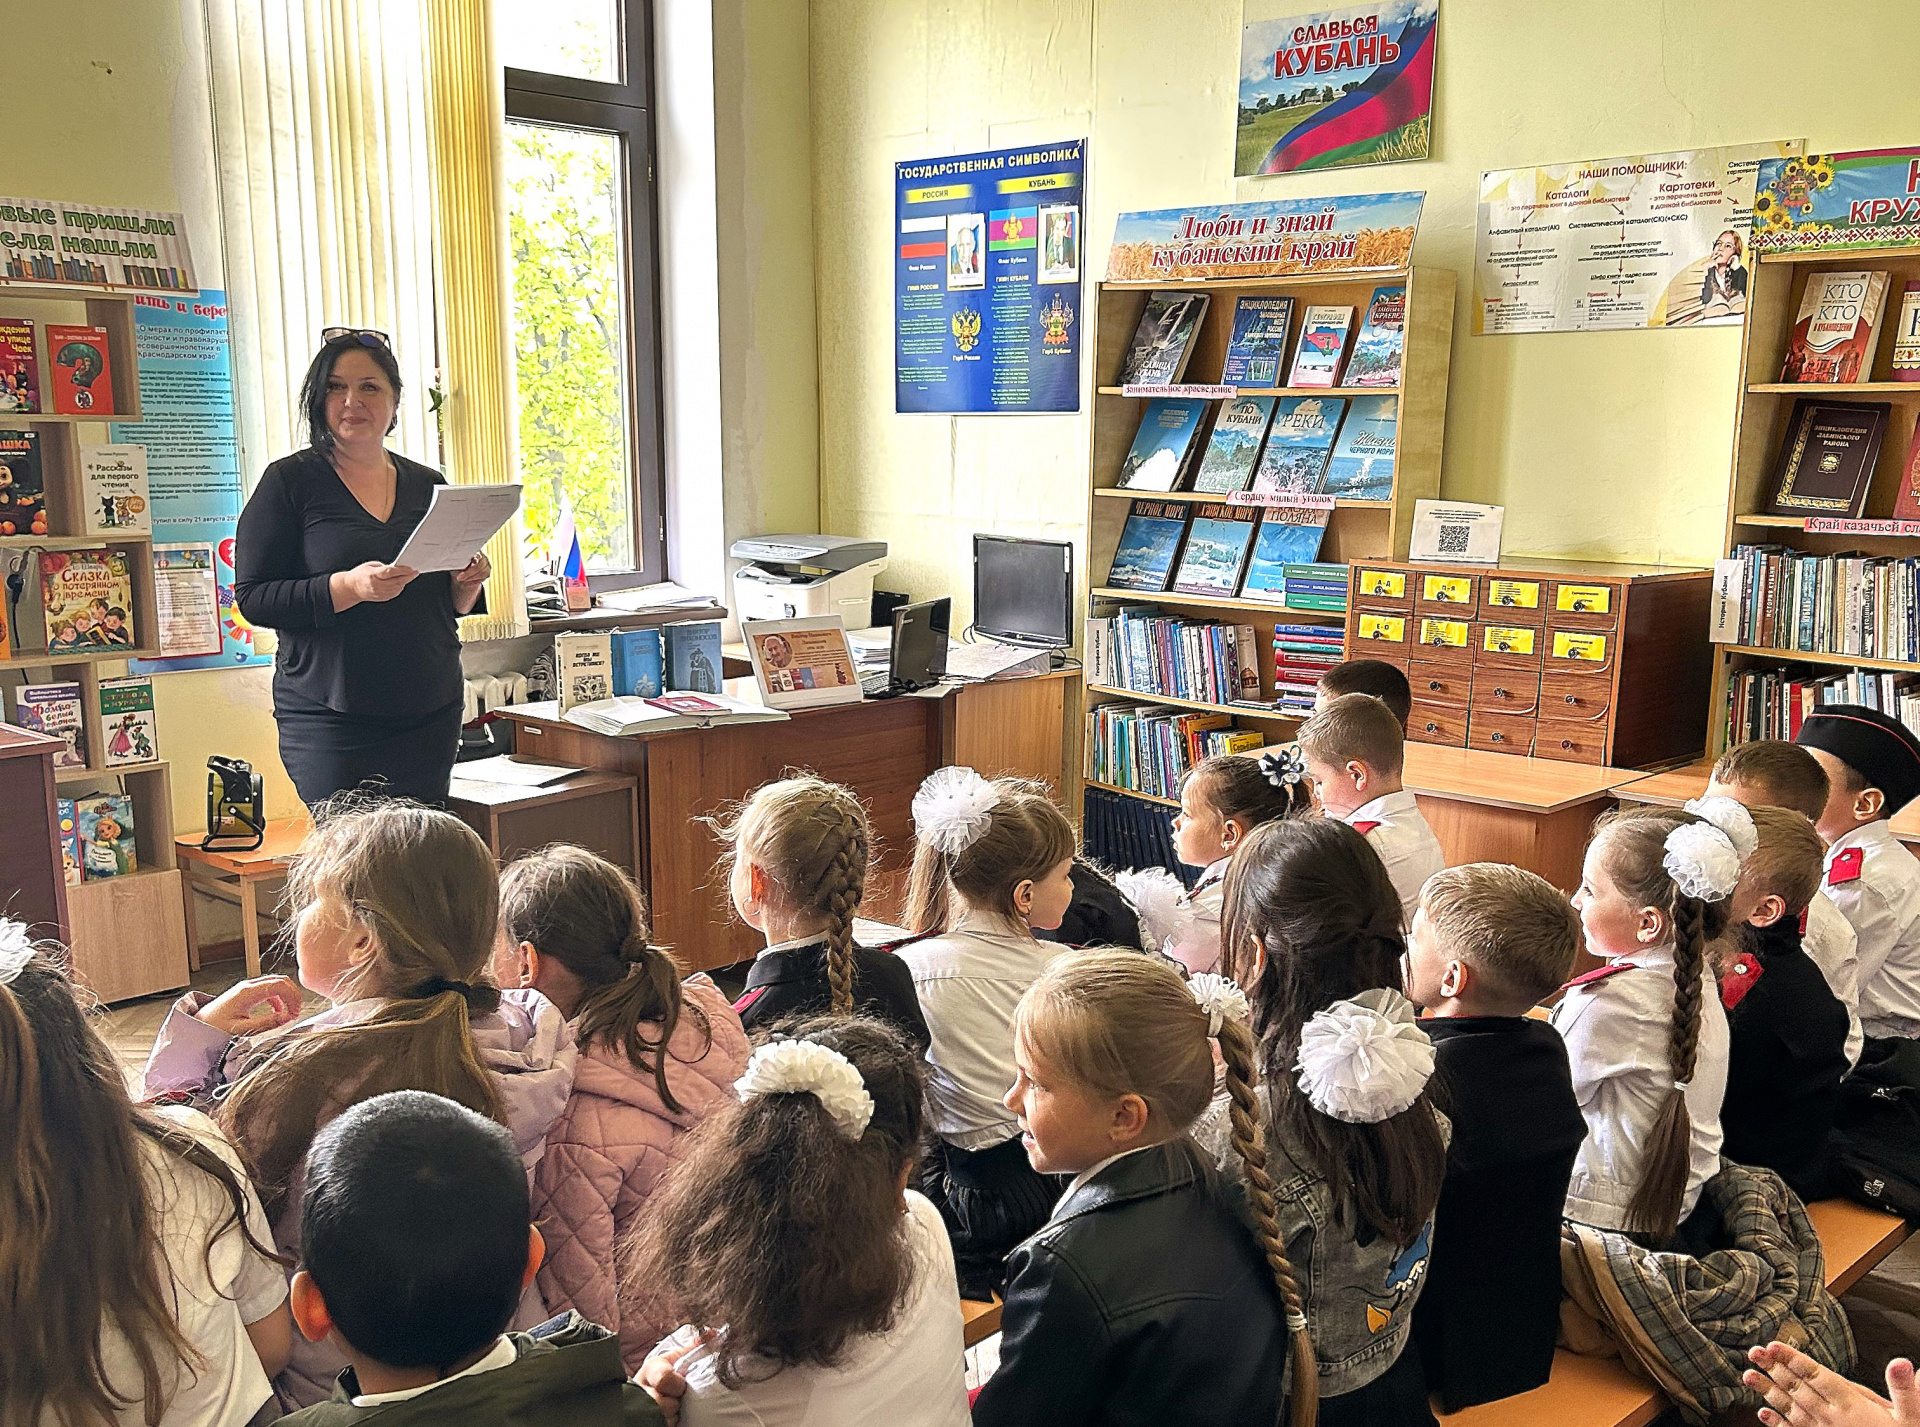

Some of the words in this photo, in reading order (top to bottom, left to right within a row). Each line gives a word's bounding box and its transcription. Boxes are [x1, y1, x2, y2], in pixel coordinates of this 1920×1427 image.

[1293, 14, 1379, 44] СЛАВЬСЯ
[1274, 34, 1401, 79] КУБАНЬ
[899, 156, 1005, 180] ГОСУДАРСТВЕННАЯ
[1008, 147, 1081, 168] СИМВОЛИКА
[1578, 168, 1610, 180] НАШИ
[1612, 160, 1688, 178] ПОМОЩНИКИ:
[1728, 160, 1760, 168] Система
[1028, 178, 1056, 188] КУБАНЬ
[1659, 180, 1715, 193] Картотеки
[922, 188, 949, 199] РОССИЯ
[1545, 188, 1590, 201] Каталоги
[0, 204, 57, 225] вые
[63, 210, 176, 236] пришли
[1173, 214, 1243, 241] Люби
[1251, 215, 1268, 237] и
[1274, 205, 1337, 234] знай
[1568, 219, 1625, 230] Систематический
[1488, 226, 1524, 236] Алфавитный
[60, 235, 158, 259] нашли
[1150, 237, 1283, 274] кубанский
[1287, 233, 1358, 269] край
[1822, 283, 1864, 300] КТО
[193, 303, 228, 320] бере
[1240, 299, 1288, 310] ЭНЦИКЛОПЕДИЯ
[1816, 304, 1858, 321] КТО
[1125, 385, 1182, 394] Занимательное
[1240, 405, 1254, 415] ПО
[1226, 414, 1263, 425] КУБАНИ
[1282, 413, 1327, 429] РЕКИ
[96, 464, 133, 472] Рассказы
[107, 473, 139, 482] первого
[1235, 491, 1266, 502] Сердцу
[1270, 493, 1299, 503] милый
[1302, 495, 1332, 504] уголок
[1135, 501, 1165, 517] ЧЕРНОЕ
[1165, 503, 1185, 519] МОРЕ
[1235, 505, 1254, 520] МОРЕ
[1270, 511, 1318, 525] ПОЛЯНА
[1808, 517, 1840, 531] Край
[1843, 520, 1900, 533] казачьей
[1904, 524, 1920, 533] сл
[63, 582, 120, 590] потерянном
[1720, 575, 1729, 600] Кубани
[65, 590, 110, 599] времени
[1718, 601, 1726, 629] История
